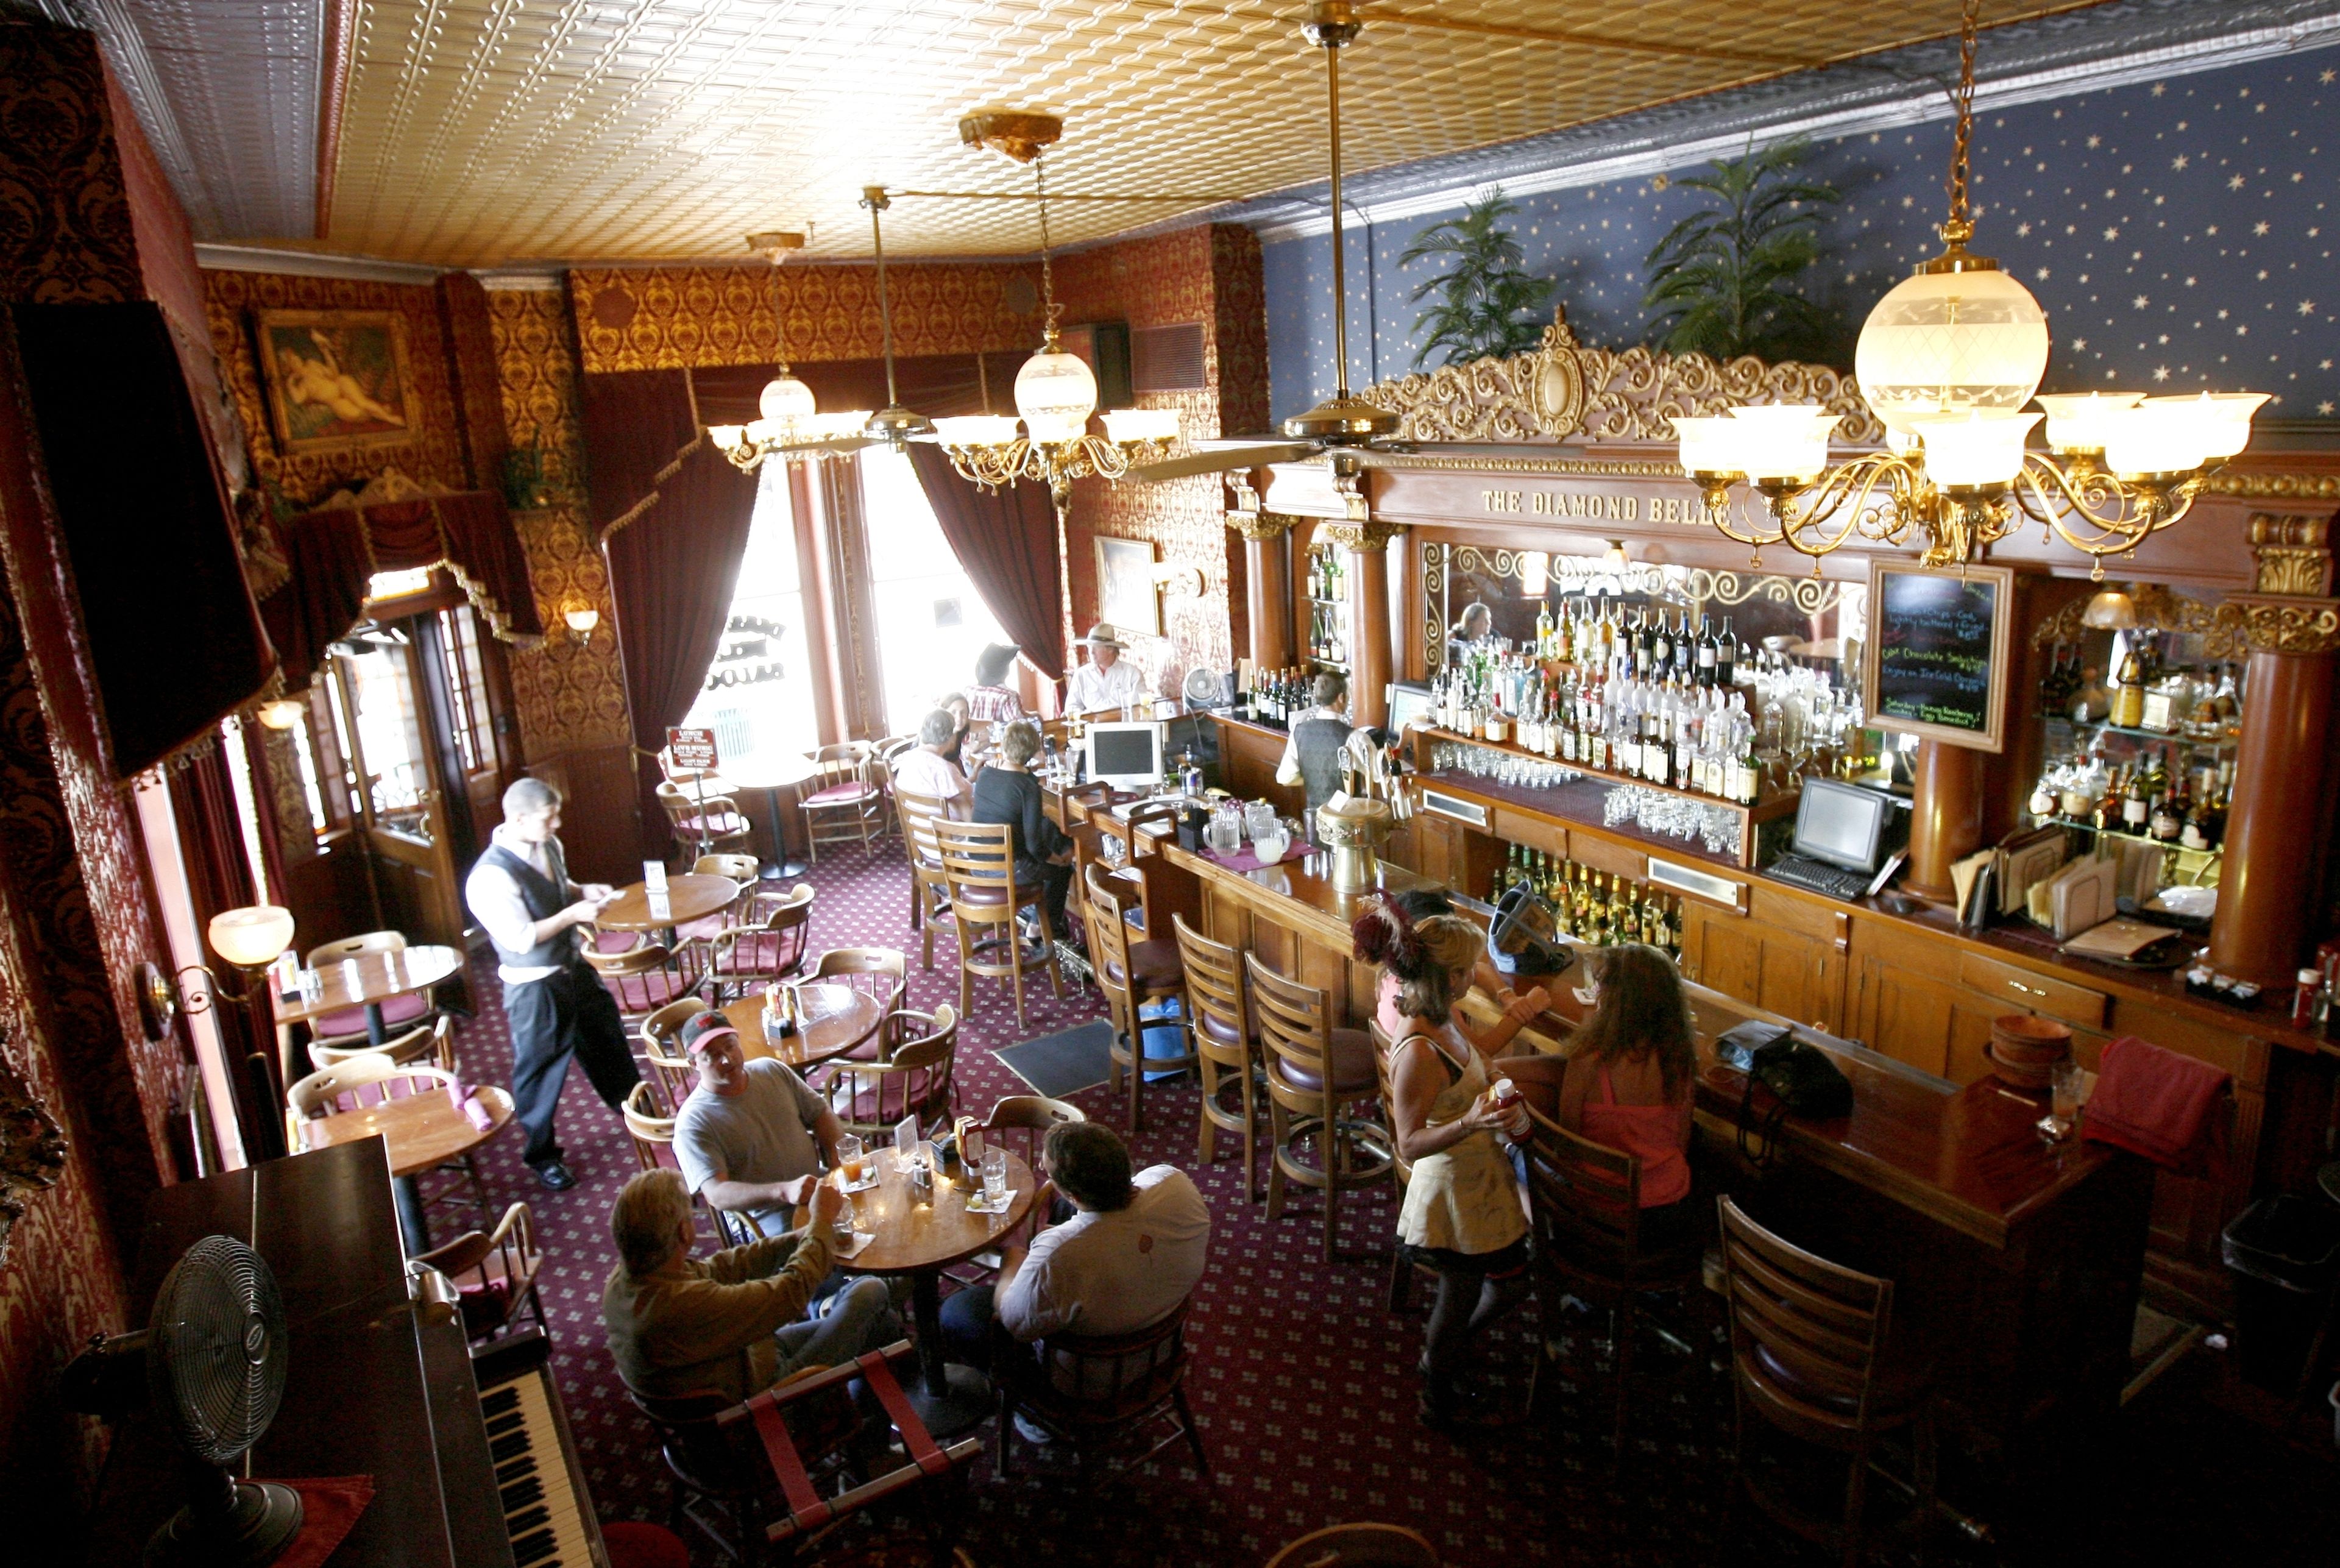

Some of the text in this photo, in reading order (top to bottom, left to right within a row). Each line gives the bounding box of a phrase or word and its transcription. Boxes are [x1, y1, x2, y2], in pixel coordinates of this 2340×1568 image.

[1482, 490, 1732, 527] THE DIAMOND BELLE
